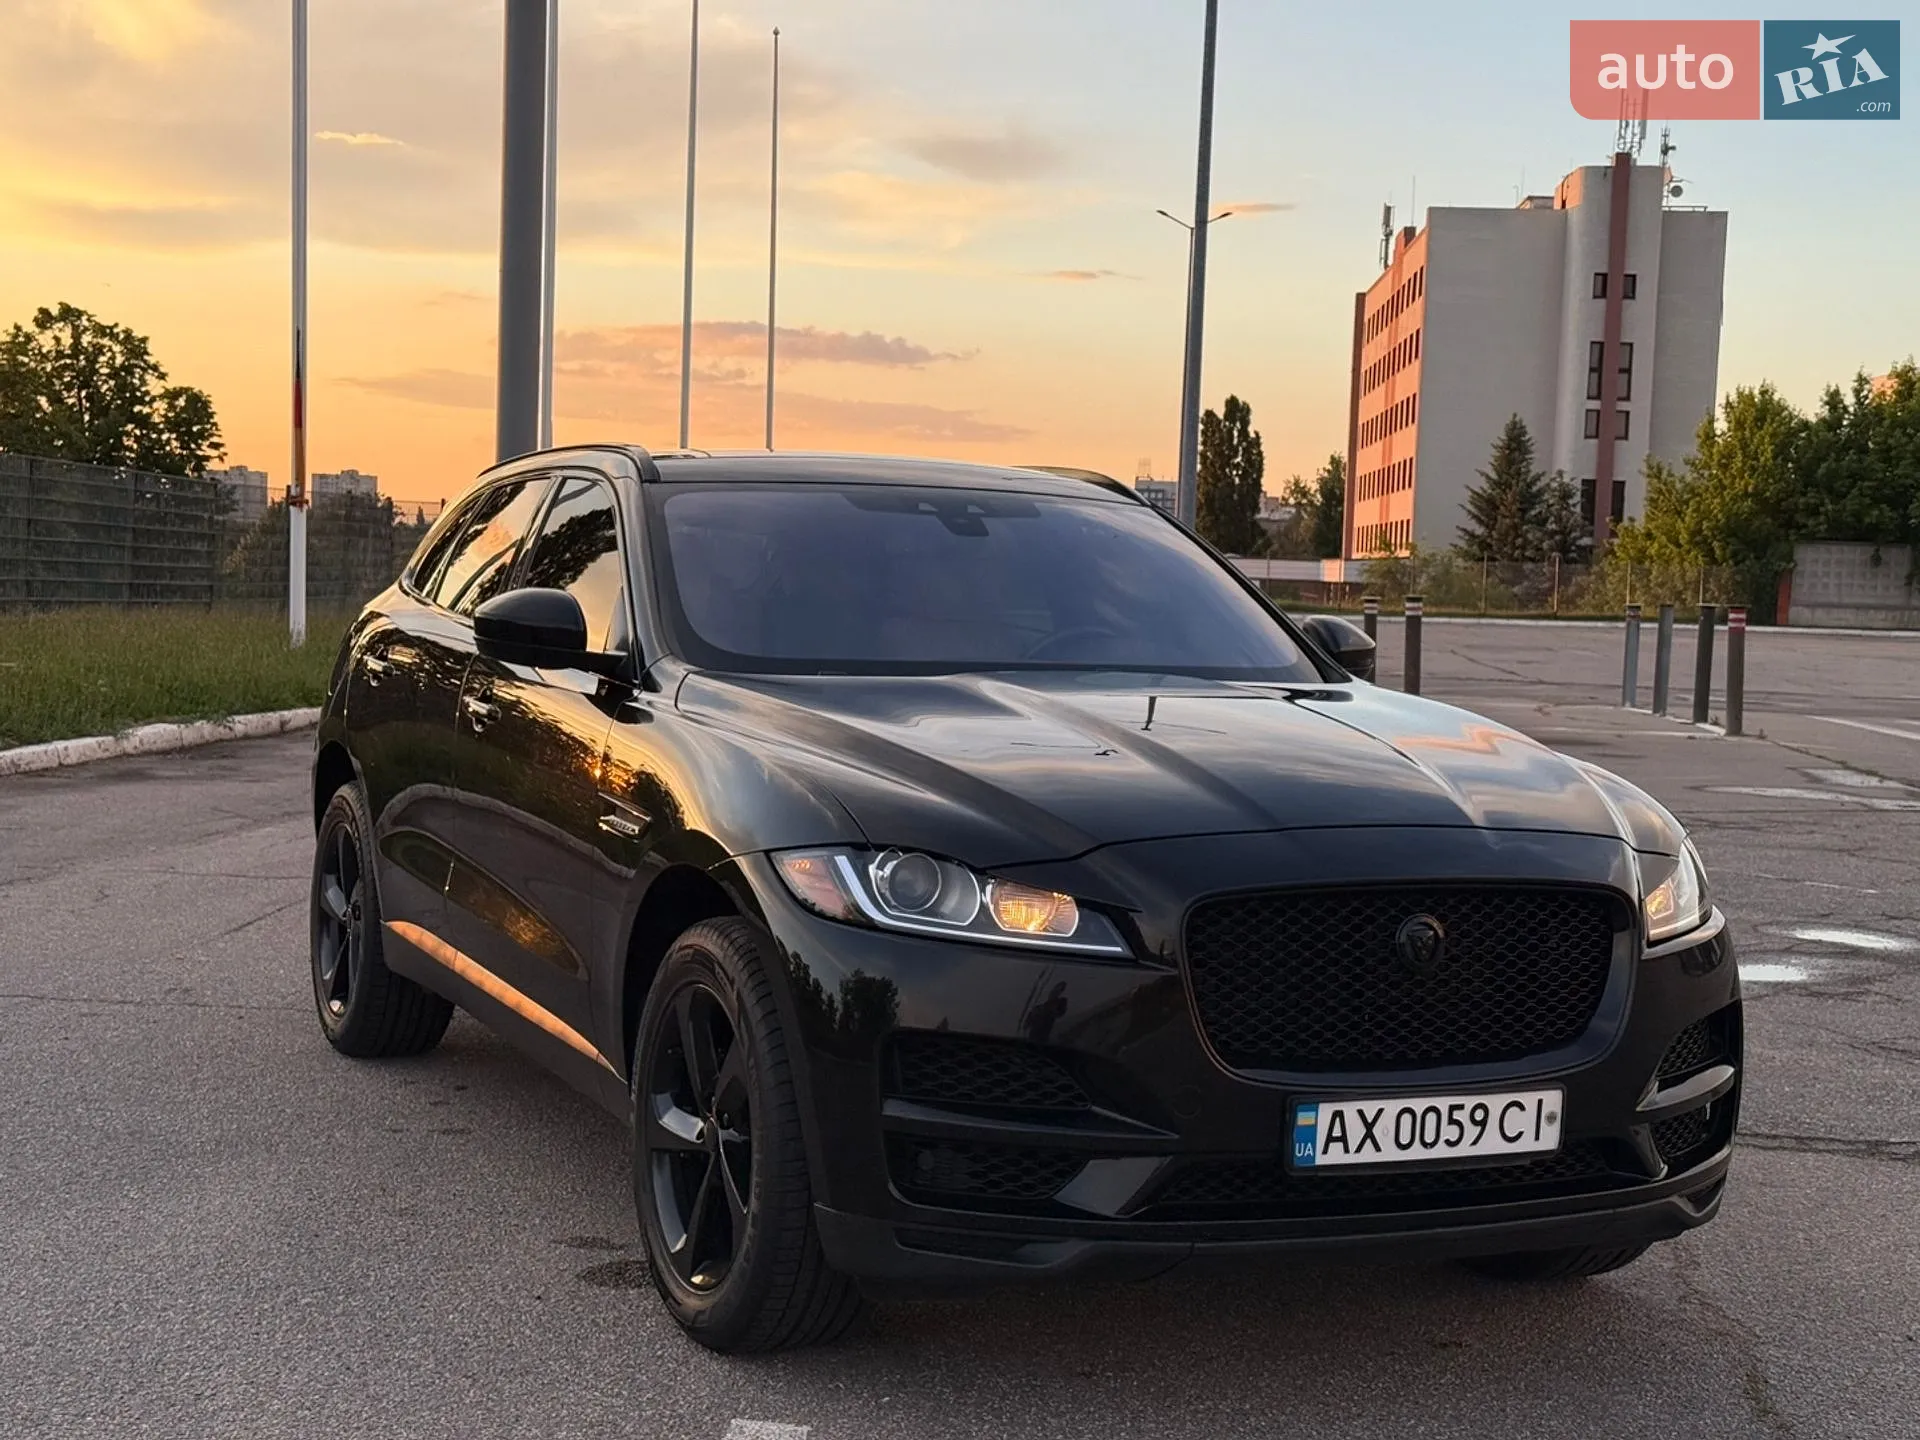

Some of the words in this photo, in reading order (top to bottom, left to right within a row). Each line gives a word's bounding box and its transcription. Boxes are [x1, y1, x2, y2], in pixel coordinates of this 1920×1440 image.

[1321, 1107, 1385, 1155] AX
[1394, 1101, 1490, 1151] 0059
[1499, 1098, 1544, 1144] CI
[1295, 1142, 1314, 1157] UA
